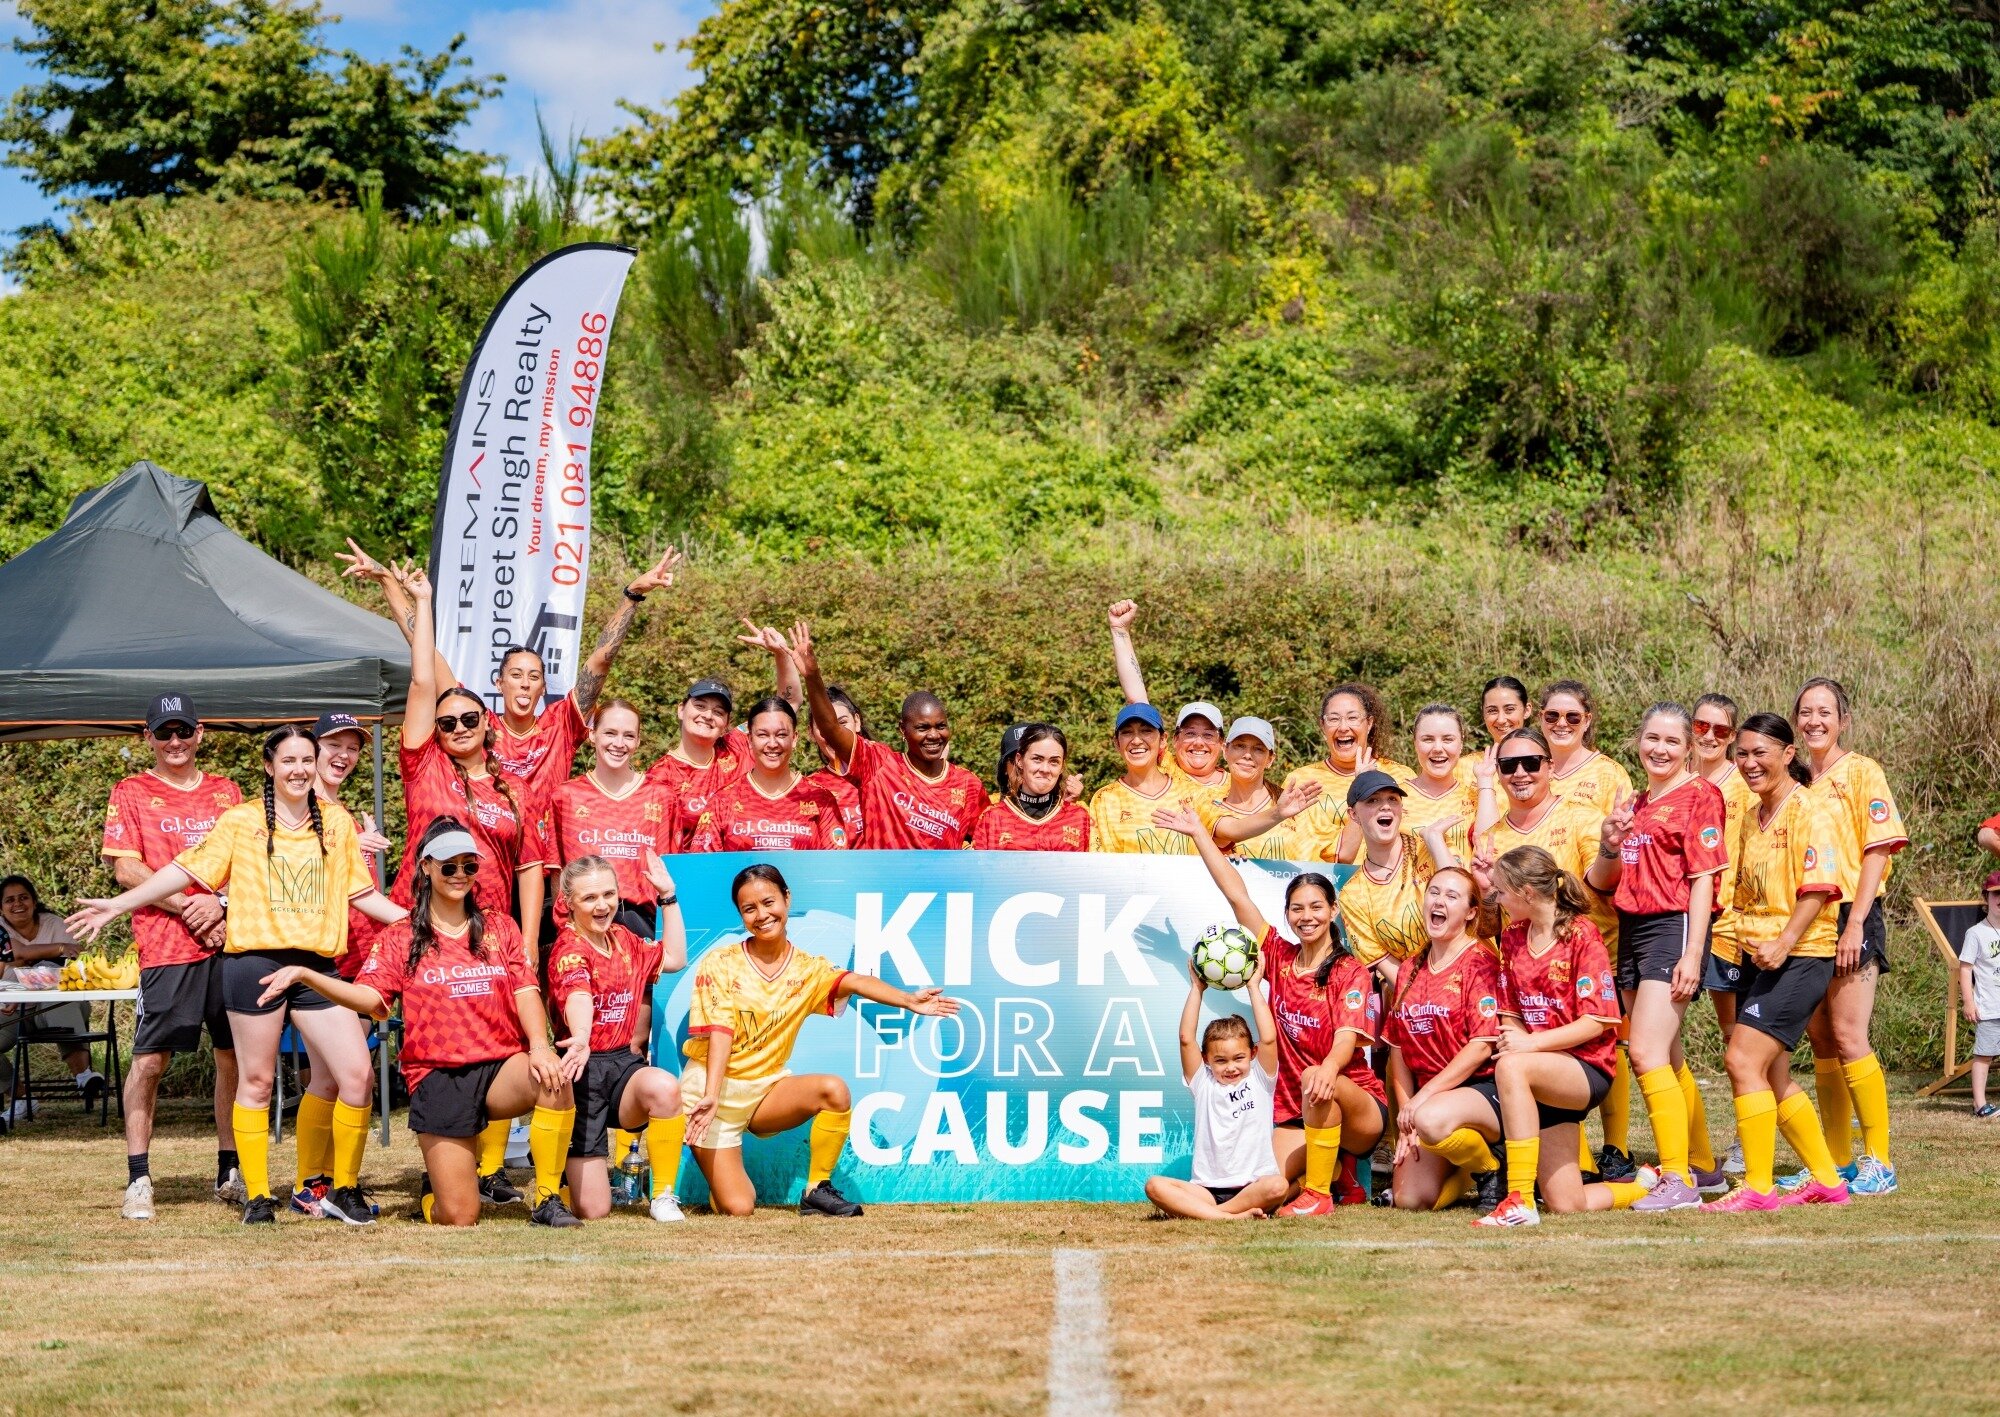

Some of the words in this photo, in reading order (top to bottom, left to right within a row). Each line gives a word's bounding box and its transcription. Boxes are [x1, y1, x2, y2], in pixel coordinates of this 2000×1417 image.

[504, 302, 552, 422] Realty
[568, 312, 607, 429] 94886
[542, 349, 561, 418] mission
[539, 422, 554, 448] my
[531, 452, 550, 513] dream,
[561, 443, 587, 508] 081
[491, 435, 531, 540] Singh
[527, 517, 542, 556] Your
[551, 523, 585, 587] 021
[1577, 781, 1597, 789] KICK
[1573, 791, 1594, 800] CAUSE
[1725, 800, 1738, 808] ICK
[476, 809, 498, 825] MES
[893, 791, 914, 811] G.J.
[918, 802, 960, 831] Gardner.
[161, 817, 184, 833] G.J.
[733, 821, 754, 836] G.J.
[757, 819, 812, 836] Gardner.
[909, 816, 944, 836] HOMES
[578, 829, 601, 845] G.J.
[604, 828, 656, 847] Gardner.
[754, 837, 791, 848] HOMES
[601, 846, 638, 857] HOMES
[1416, 861, 1430, 874] ICK
[270, 906, 308, 914] MCKENZIE
[854, 891, 1160, 986] KICK
[423, 968, 450, 984] G.J.
[451, 981, 490, 995] HOMES
[855, 997, 1064, 1079] FOR
[1083, 997, 1165, 1077] A
[1232, 1101, 1255, 1118] CUSE
[850, 1089, 1164, 1166] CAUSE
